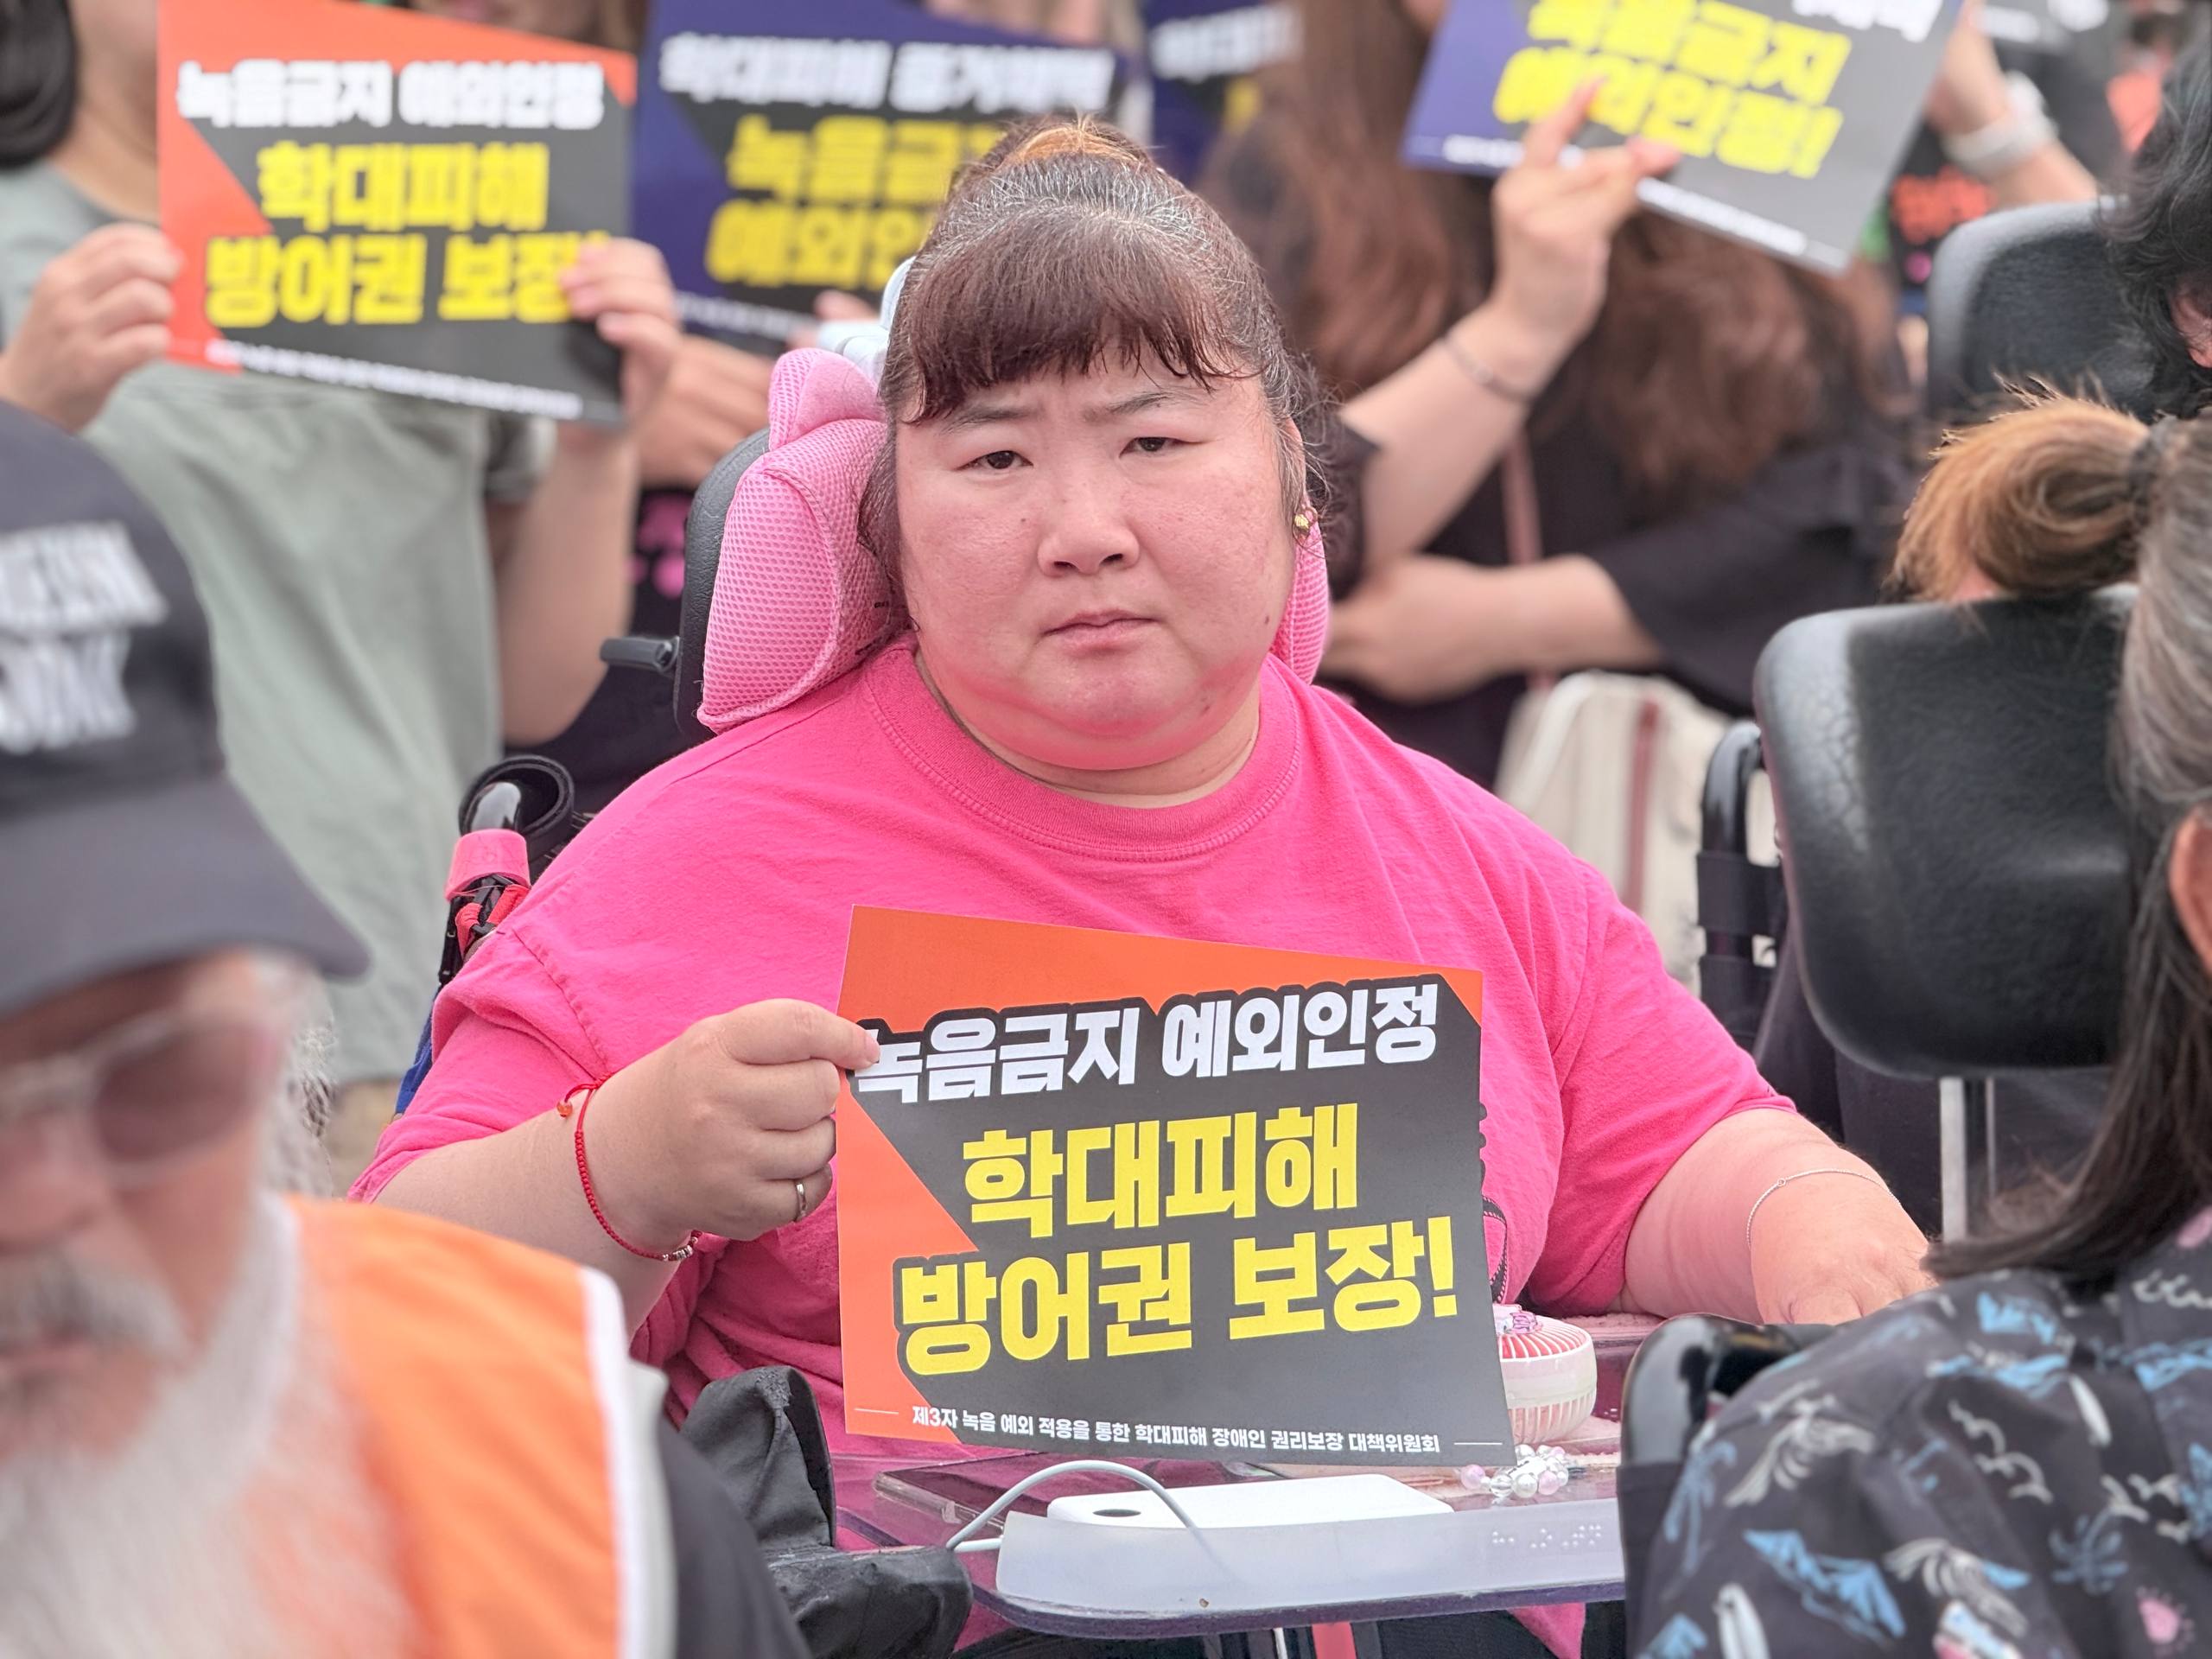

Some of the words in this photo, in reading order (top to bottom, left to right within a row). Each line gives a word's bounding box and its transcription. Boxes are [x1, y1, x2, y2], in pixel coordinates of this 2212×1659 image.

[257, 140, 550, 232] 학대피해
[206, 234, 428, 328] 방어권
[855, 1007, 1141, 1103] 녹음금지
[1161, 983, 1439, 1078] 예외인정
[963, 1103, 1359, 1239] 학대피해
[900, 1243, 1192, 1376] 방어권
[1228, 1215, 1459, 1341] 보장!
[912, 1406, 958, 1429] 제3자
[962, 1409, 996, 1433] 녹음
[1000, 1414, 1034, 1436] 예외
[1039, 1417, 1090, 1440] 적용을
[1095, 1421, 1131, 1443] 통한
[1135, 1423, 1208, 1446] 학대피해
[1211, 1427, 1267, 1449] 장애인
[1271, 1430, 1344, 1452] 권리보장
[1348, 1433, 1441, 1453] 대책위원회
